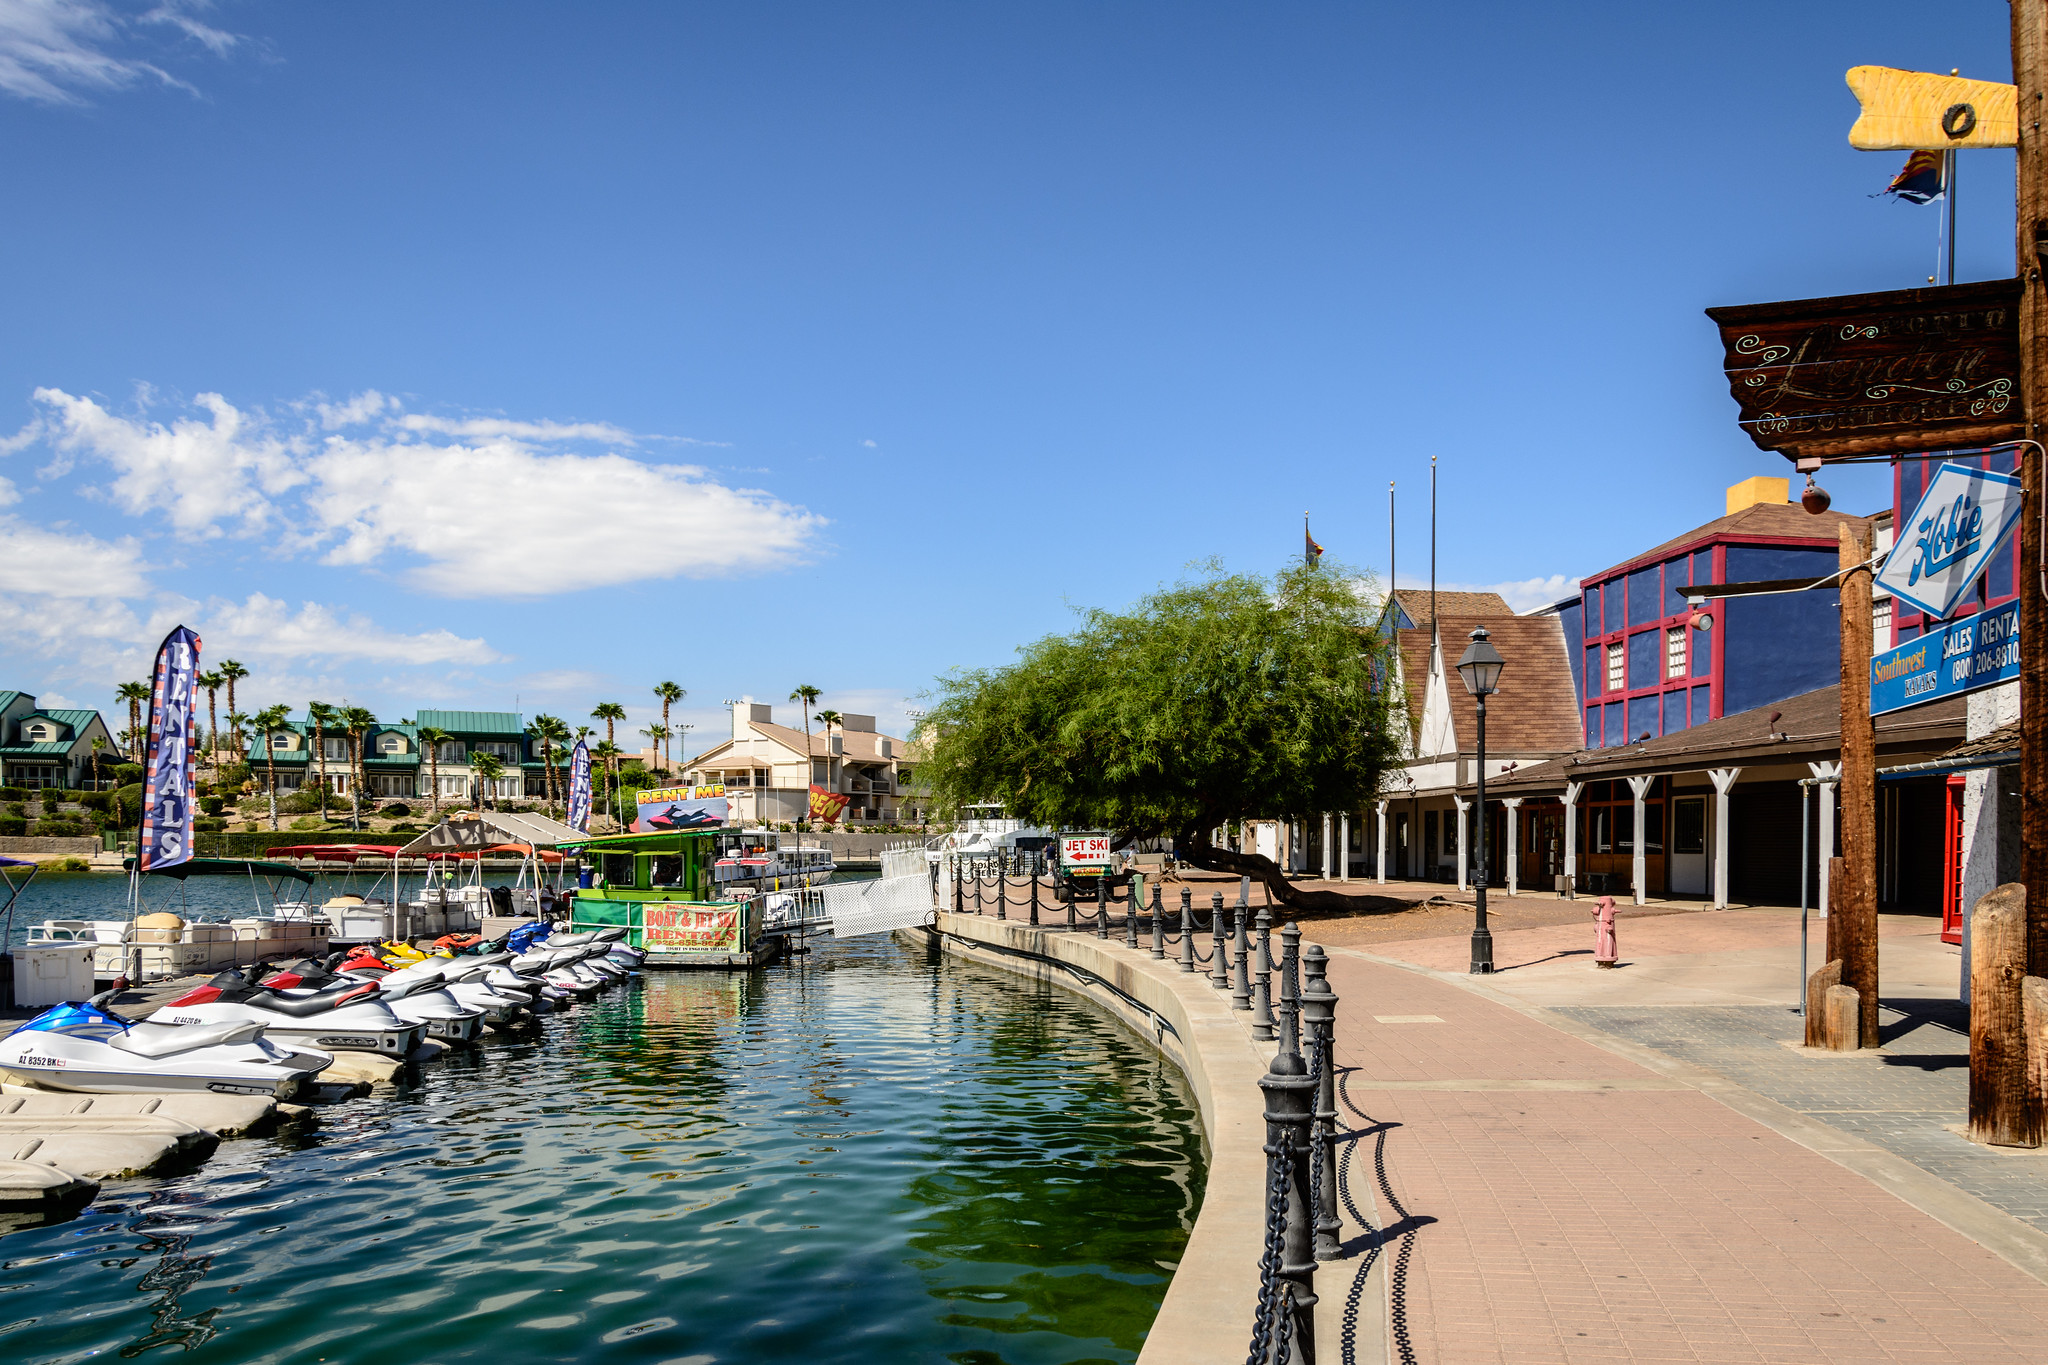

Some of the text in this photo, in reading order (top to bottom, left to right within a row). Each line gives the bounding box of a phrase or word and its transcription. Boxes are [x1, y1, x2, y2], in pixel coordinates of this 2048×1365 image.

[1908, 493, 1983, 587] Hobie
[1942, 625, 1972, 660] SALES
[1873, 646, 1927, 685] Southwest
[1952, 640, 2020, 685] (800) 206-8810
[1904, 670, 1938, 698] KAYAKS
[160, 641, 191, 860] RENTALS
[637, 784, 725, 805] RENT ME
[810, 791, 842, 818] PEN
[1065, 839, 1108, 851] JET SKI
[646, 910, 737, 929] BOAT & JET SKI
[646, 928, 737, 941] RENTALS
[19, 1055, 27, 1065] AZ
[28, 1056, 46, 1067] 8352
[47, 1058, 57, 1067] BK
